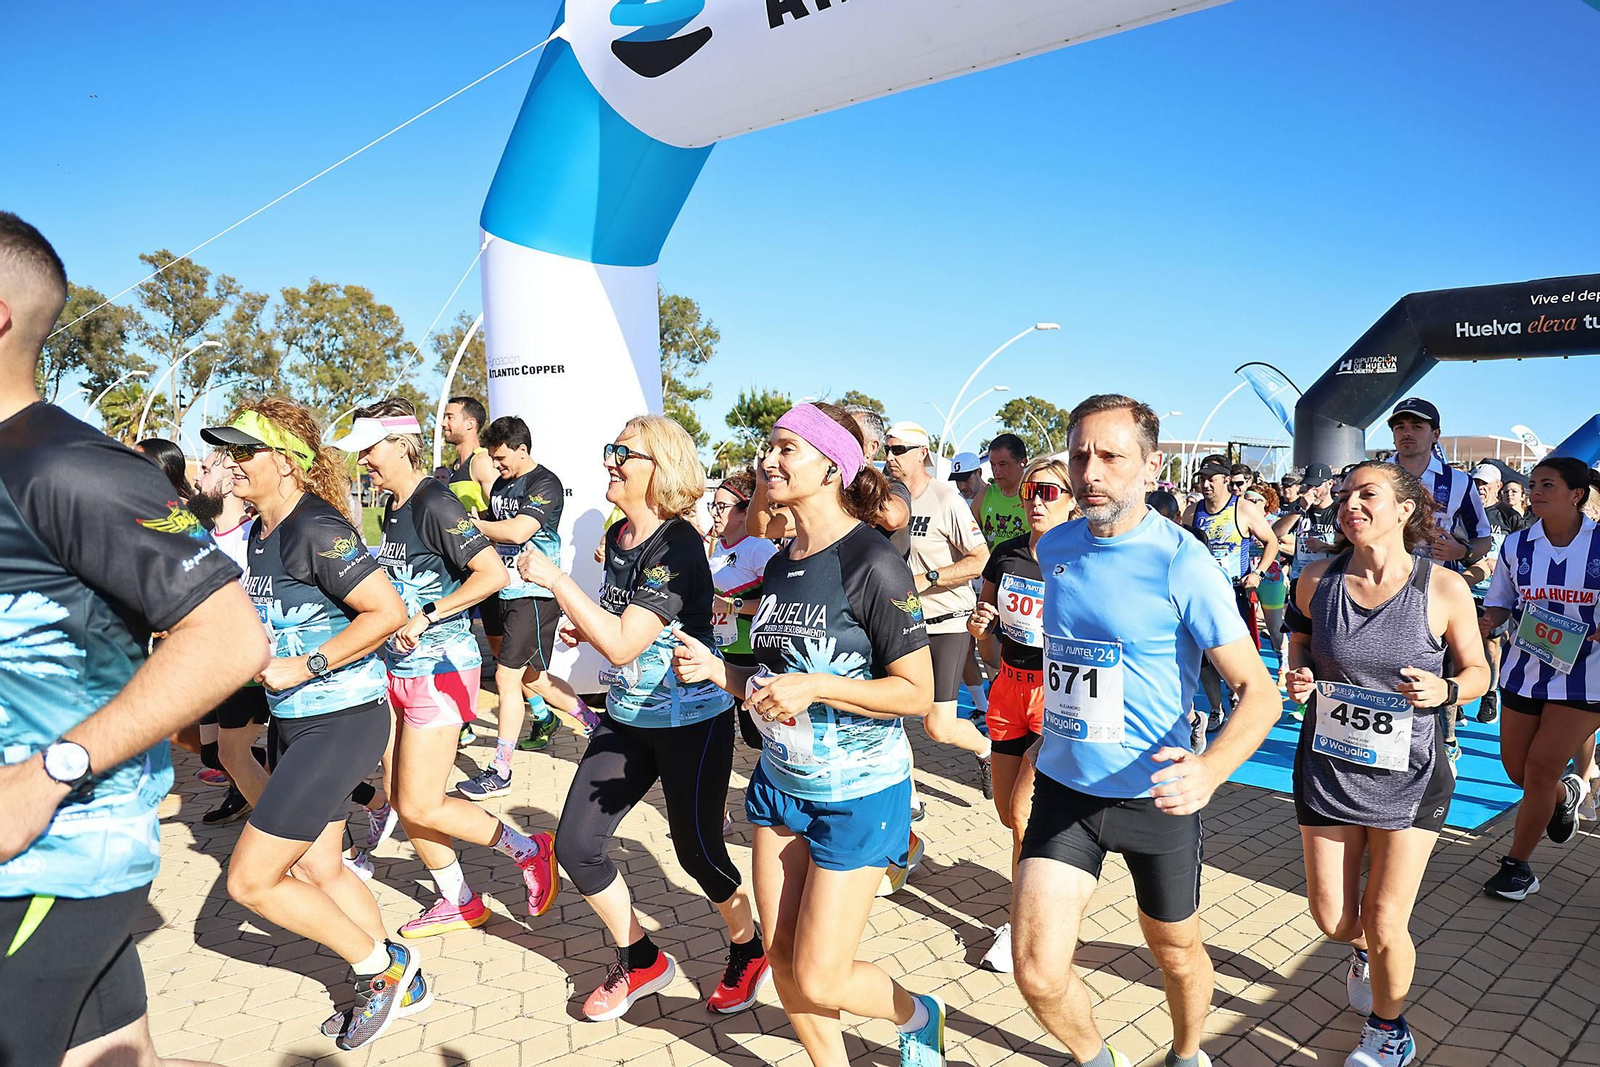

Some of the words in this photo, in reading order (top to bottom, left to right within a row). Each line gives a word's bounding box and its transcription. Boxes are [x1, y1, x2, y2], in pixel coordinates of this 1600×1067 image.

[1530, 294, 1559, 306] Vive
[1562, 291, 1575, 304] el
[1456, 319, 1522, 338] Huelva
[1527, 314, 1578, 335] eleva
[489, 366, 520, 379] ATLANTIC
[521, 364, 566, 376] COPPER
[1365, 361, 1398, 370] HUELVA
[1549, 588, 1594, 604] HUELVA
[1006, 593, 1044, 618] 307
[766, 602, 827, 629] HUELVA
[1535, 622, 1564, 645] 60
[1093, 647, 1116, 663] '24
[1048, 661, 1098, 699] 671
[1059, 703, 1082, 712] ALEJANDRO
[1386, 696, 1408, 710] '24
[1330, 702, 1394, 735] 458
[1329, 740, 1371, 760] Wayalia
